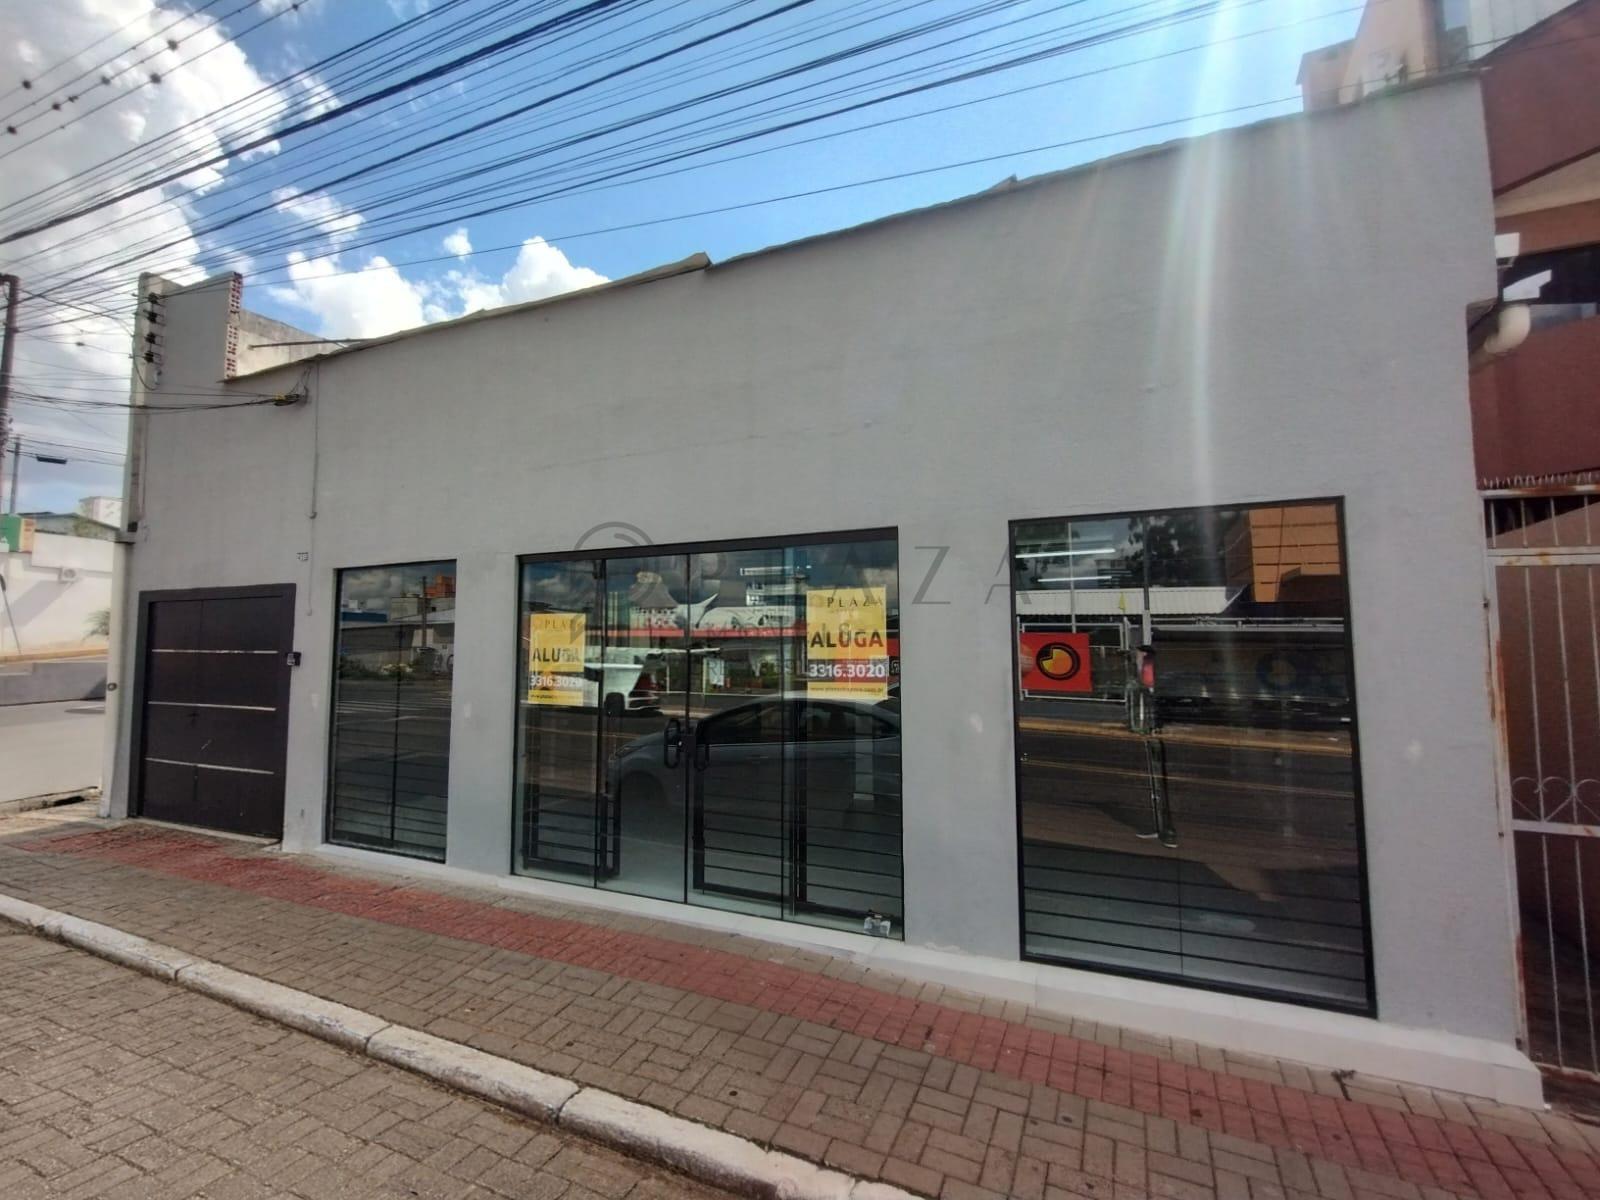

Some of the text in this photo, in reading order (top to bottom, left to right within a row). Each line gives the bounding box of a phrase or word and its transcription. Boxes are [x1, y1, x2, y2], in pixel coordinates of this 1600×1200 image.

[544, 619, 583, 630] PLA
[810, 631, 884, 648] ALUGA
[809, 664, 886, 678] 3316.3020
